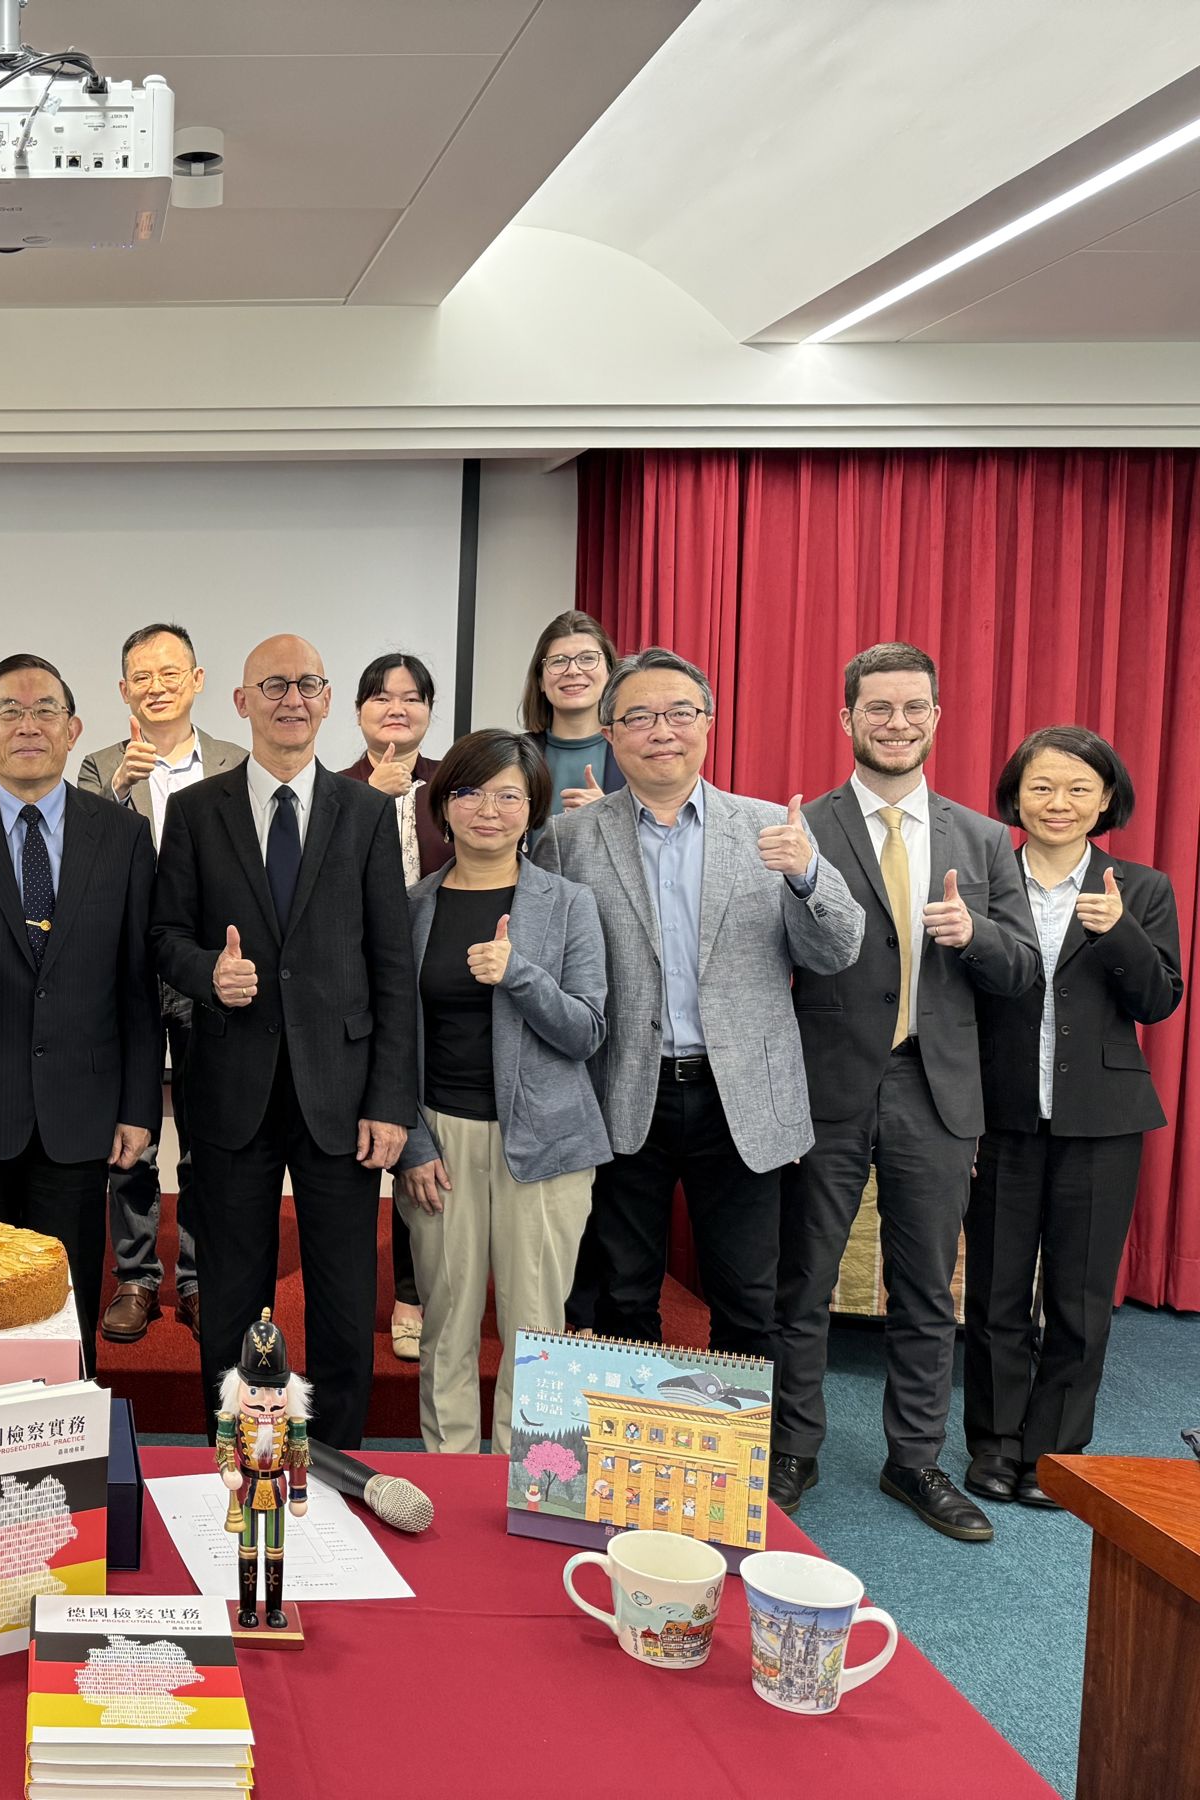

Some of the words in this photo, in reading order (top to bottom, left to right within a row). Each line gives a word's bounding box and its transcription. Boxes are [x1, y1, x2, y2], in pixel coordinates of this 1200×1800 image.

[53, 1435, 86, 1445] PRACTICE
[66, 1607, 200, 1620] 德國檢察實務
